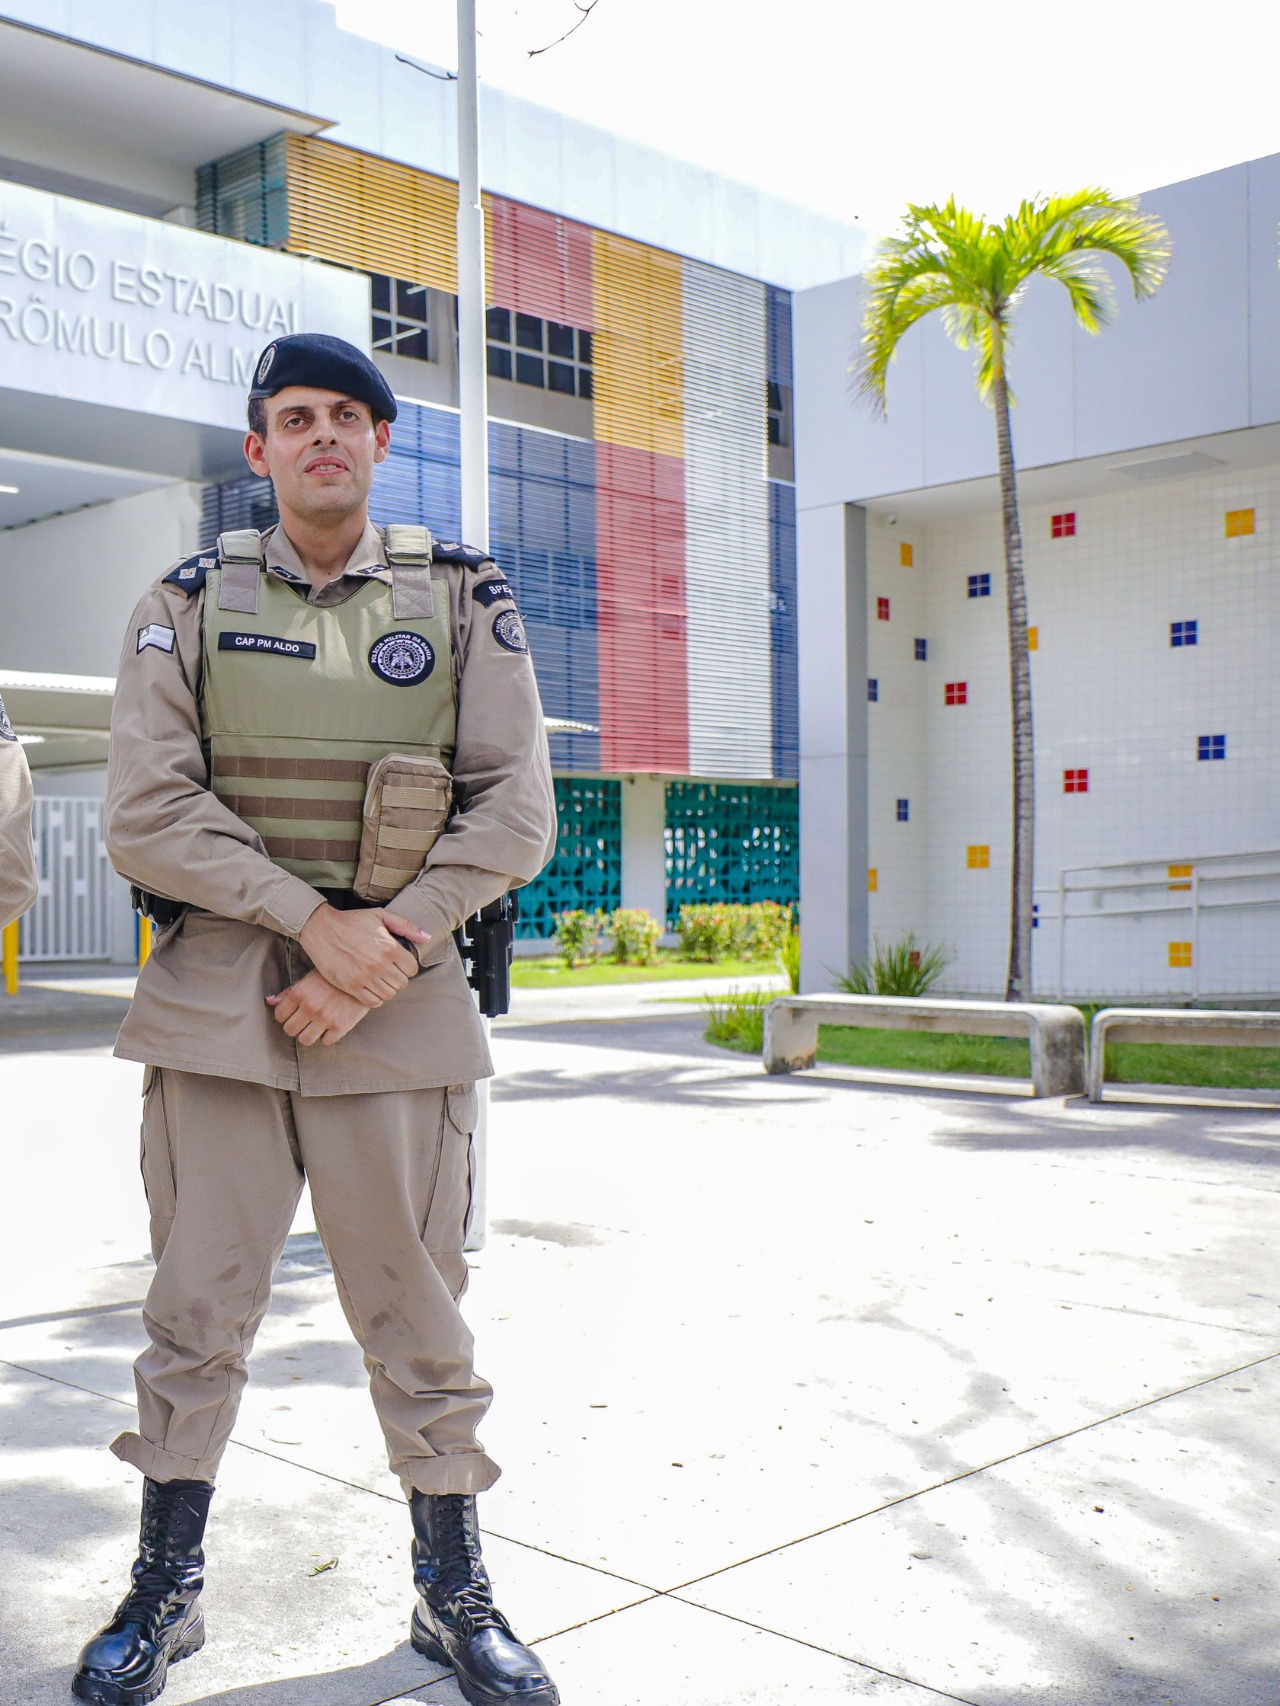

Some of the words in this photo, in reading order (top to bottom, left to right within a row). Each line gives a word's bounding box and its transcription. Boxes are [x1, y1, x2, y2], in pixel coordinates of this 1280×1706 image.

[181, 337, 258, 387] ALM
[488, 584, 512, 595] BPE
[235, 637, 255, 646] CAP
[257, 639, 271, 648] PM
[273, 641, 299, 652] ALDO
[411, 636, 421, 644] DA
